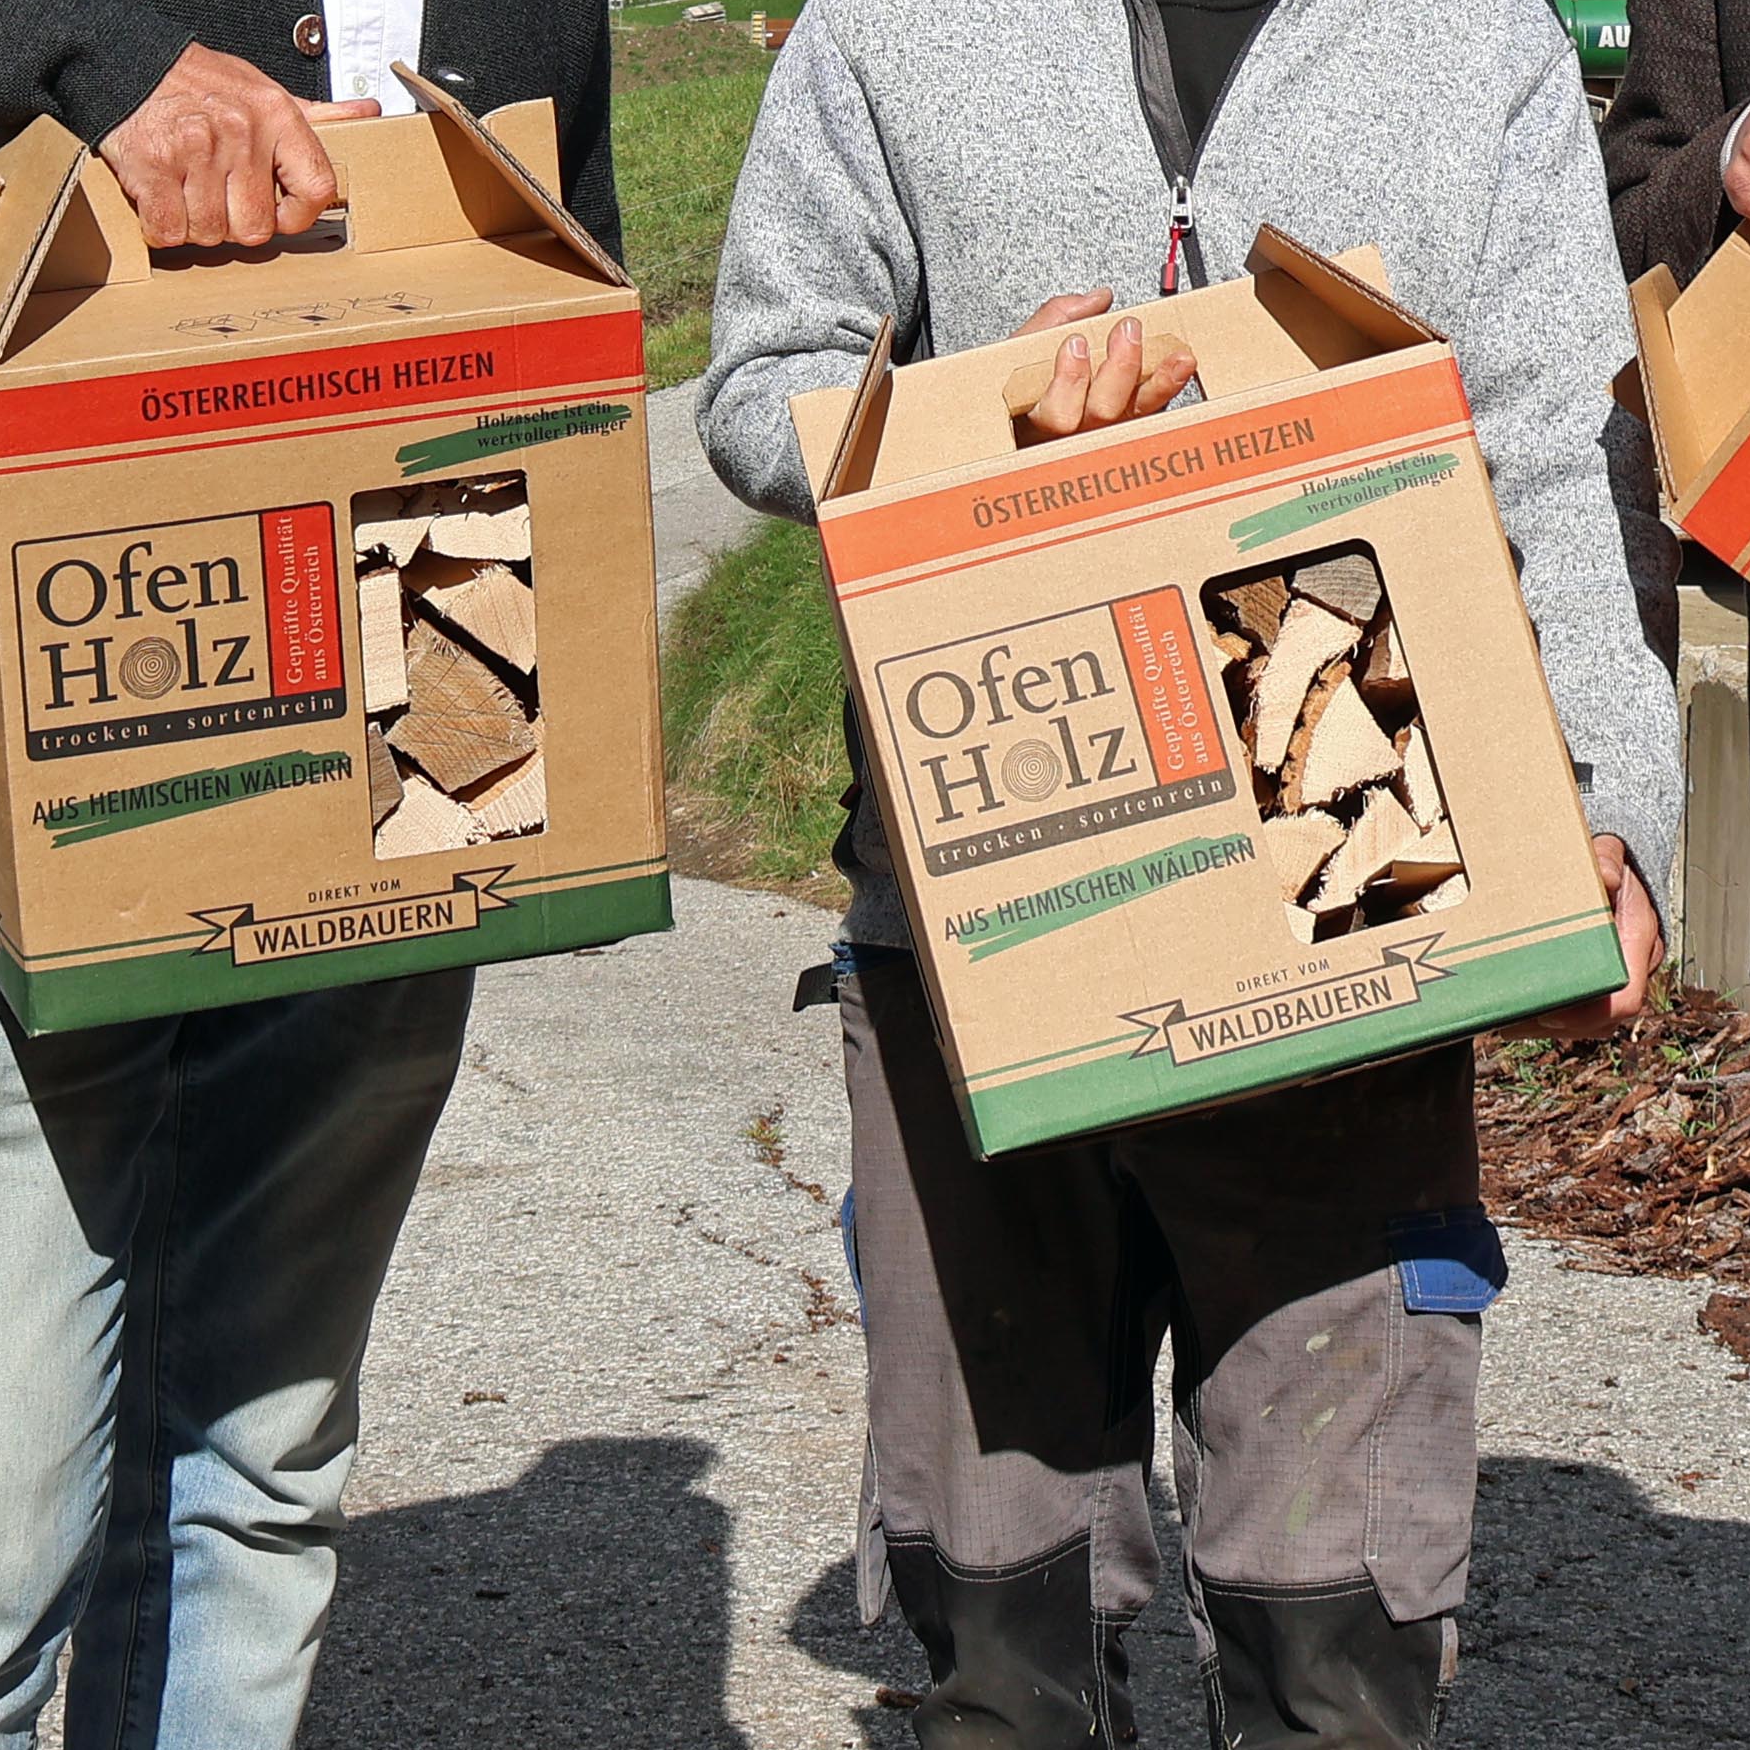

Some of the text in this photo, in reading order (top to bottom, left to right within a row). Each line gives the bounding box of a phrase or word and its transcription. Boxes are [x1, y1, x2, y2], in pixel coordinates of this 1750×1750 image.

[140, 351, 493, 421] ÖSTERREICHISCH HEIZEN
[475, 400, 611, 430] Holzasche ist ein
[477, 416, 625, 448] wertvoller Dünger
[971, 417, 1315, 529] ÖSTERREICHISCH HEIZEN
[1300, 450, 1437, 498] Holzasche ist ein
[1305, 464, 1456, 515] wertvoller Dünger
[36, 540, 248, 627] Ofen
[276, 515, 304, 684] Geprüfte Qualität
[302, 545, 326, 680] aus Österreich
[41, 694, 334, 750] trocken sortenrein
[905, 642, 1114, 739] Ofen
[1127, 603, 1186, 771] Geprüfte Qualität
[1159, 629, 1209, 764] aus Österreich
[32, 753, 352, 825] AUS HEIMISCHEN WÄLDERN
[937, 777, 1222, 865] trocken sortenrein
[307, 877, 401, 903] DIREKT VOM
[943, 834, 1255, 941] AUS HEIMISCHEN WÄLDERN
[253, 898, 453, 956] WALDBAUERN
[1188, 973, 1393, 1053] WALDBAUERN
[1235, 957, 1330, 993] DIREKT VOM
